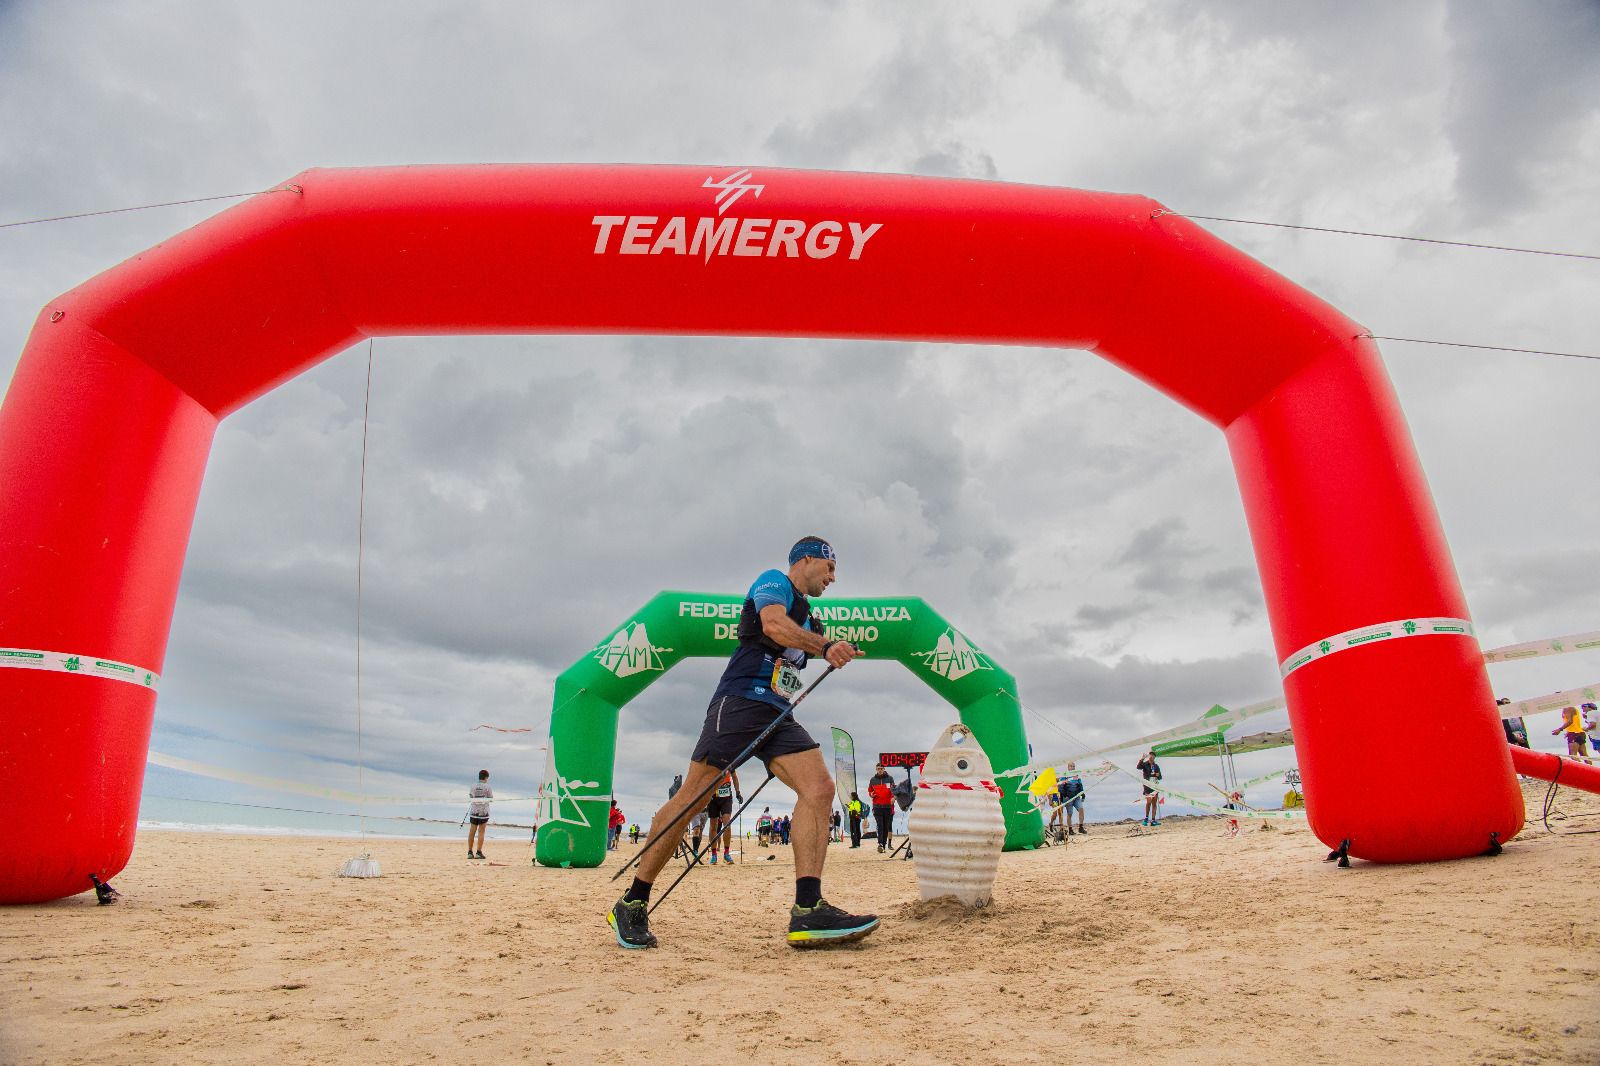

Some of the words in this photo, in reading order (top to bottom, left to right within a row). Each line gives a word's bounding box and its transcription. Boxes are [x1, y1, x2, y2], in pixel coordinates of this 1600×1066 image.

[591, 215, 883, 266] TEAMERGY
[812, 605, 911, 621] ANDALUZA
[714, 623, 739, 639] DE
